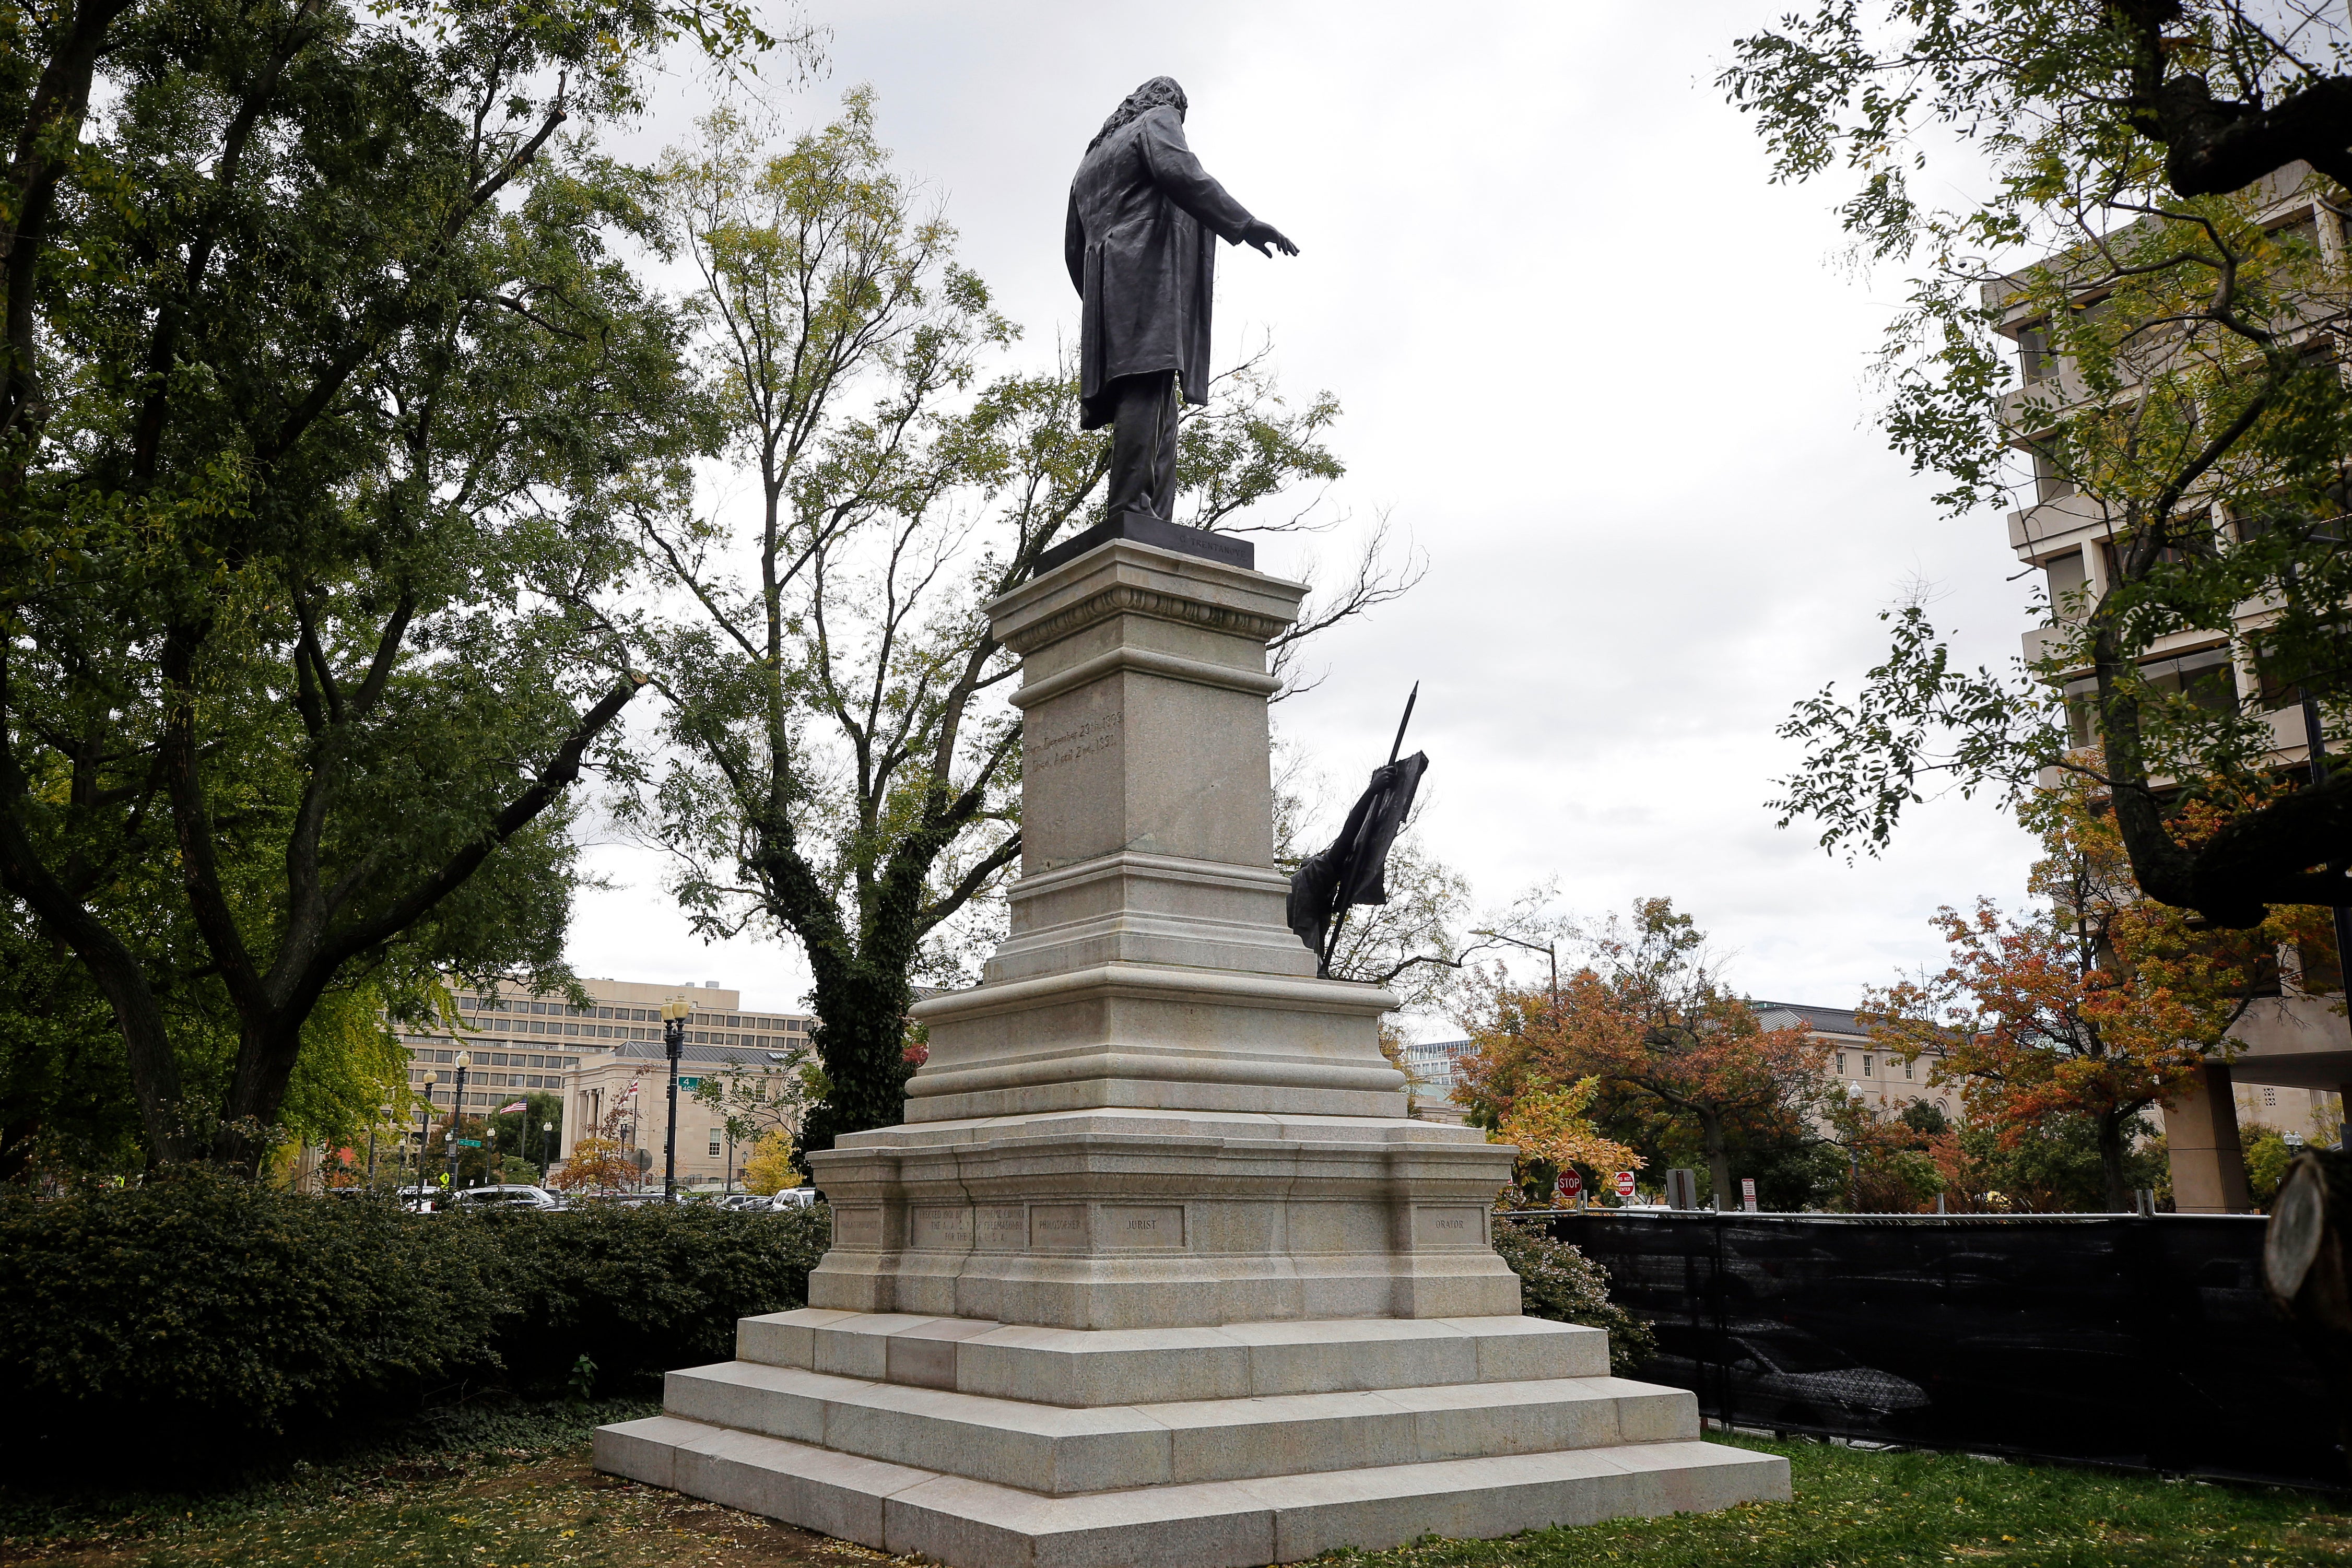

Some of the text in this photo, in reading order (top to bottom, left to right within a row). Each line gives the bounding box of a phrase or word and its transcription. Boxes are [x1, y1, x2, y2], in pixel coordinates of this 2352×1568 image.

[1560, 1178, 1580, 1188] STOP
[931, 1221, 940, 1230] THE
[1039, 1220, 1080, 1229] PHILOSOPHER
[1126, 1220, 1156, 1230] JURIST
[1436, 1220, 1463, 1229] ORATOR
[945, 1233, 955, 1241] FOR
